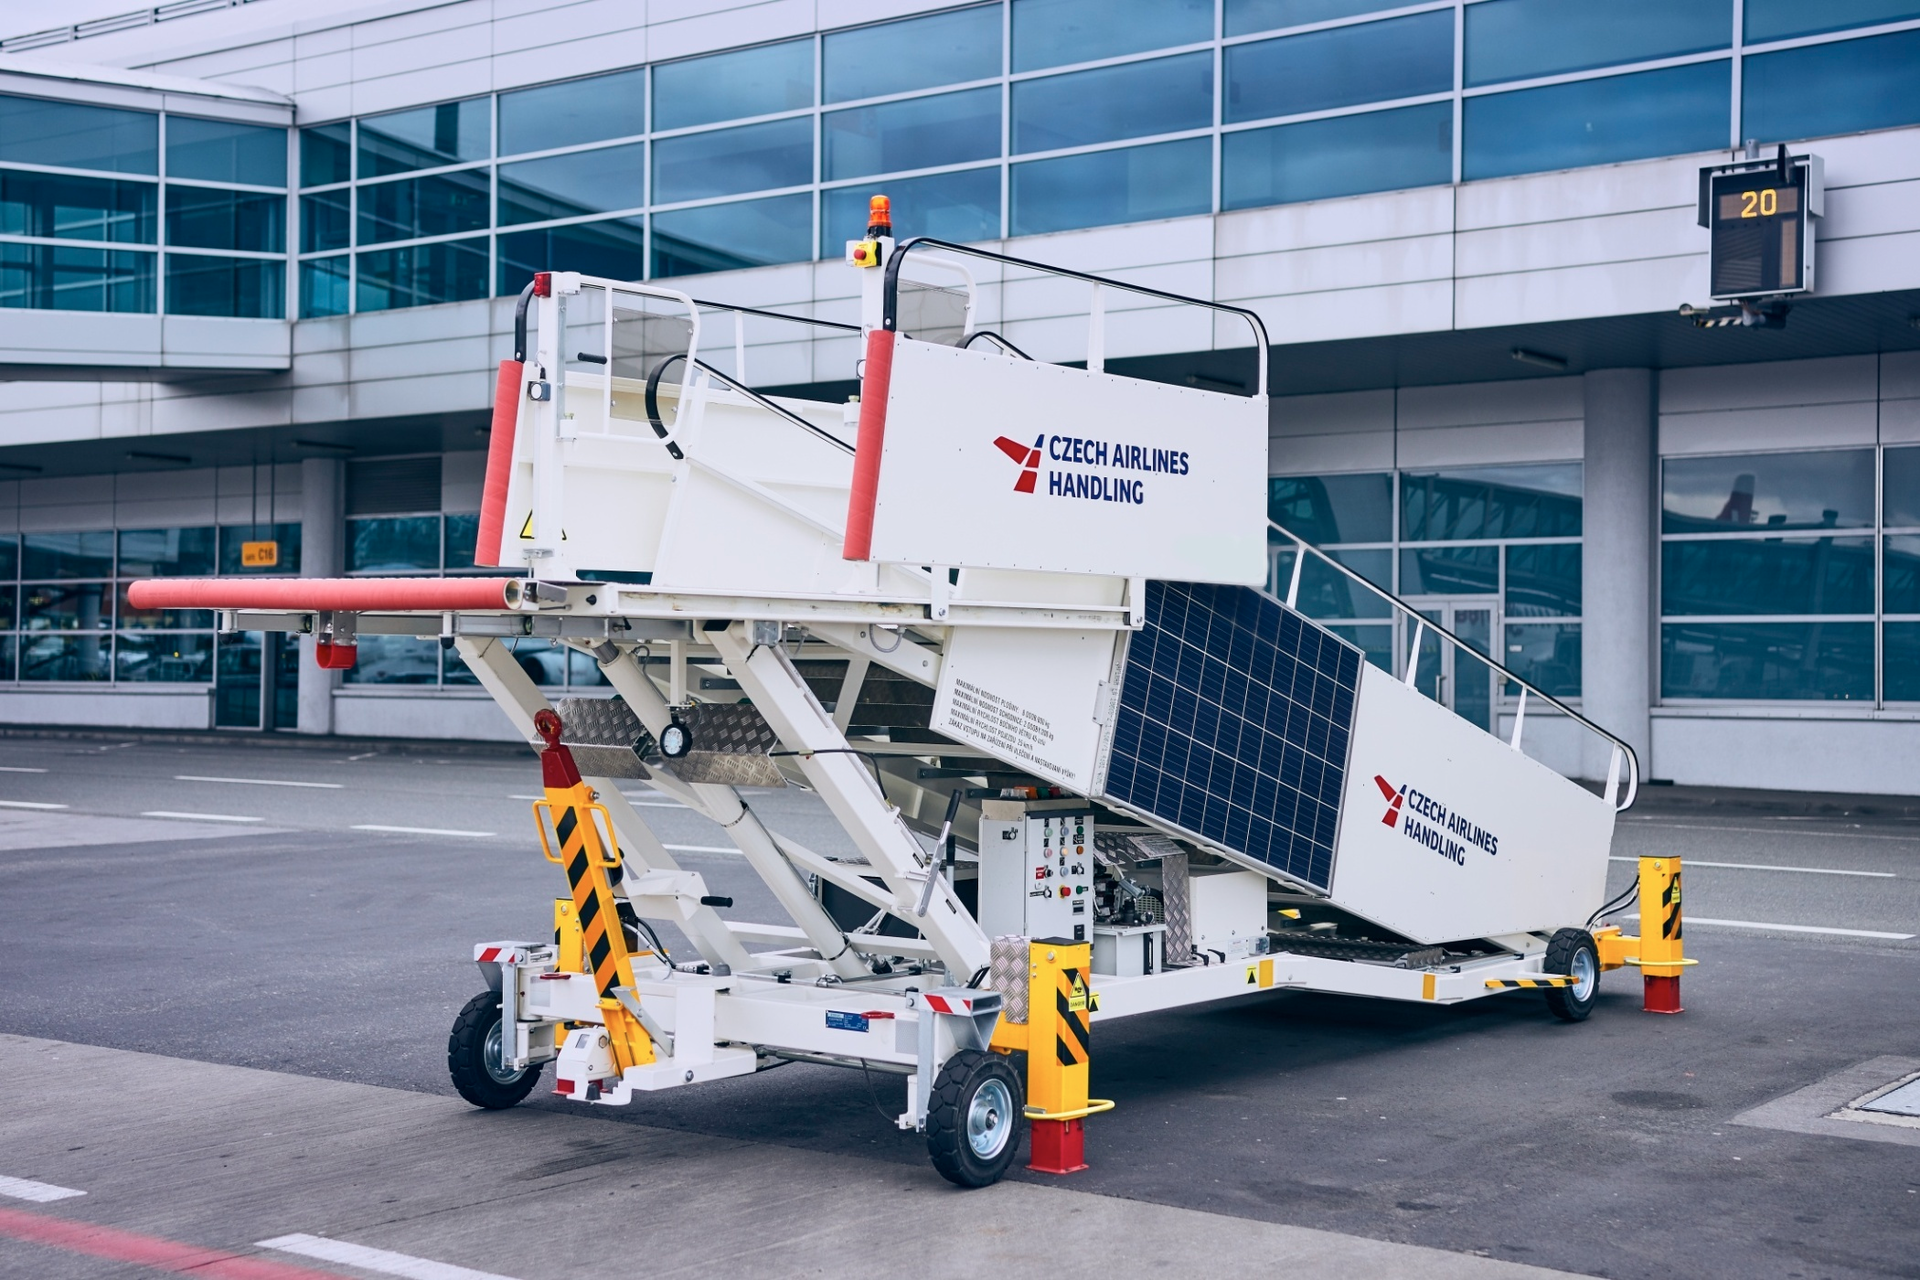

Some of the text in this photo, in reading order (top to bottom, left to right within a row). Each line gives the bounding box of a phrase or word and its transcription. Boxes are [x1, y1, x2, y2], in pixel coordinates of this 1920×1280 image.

[1740, 187, 1778, 219] 20
[1049, 435, 1189, 475] CZECH AIRLINES
[1049, 471, 1144, 505] HANDLING
[258, 548, 274, 561] C16
[1404, 815, 1466, 867] HANDLING
[1408, 789, 1498, 856] CZECH AIRLINES
